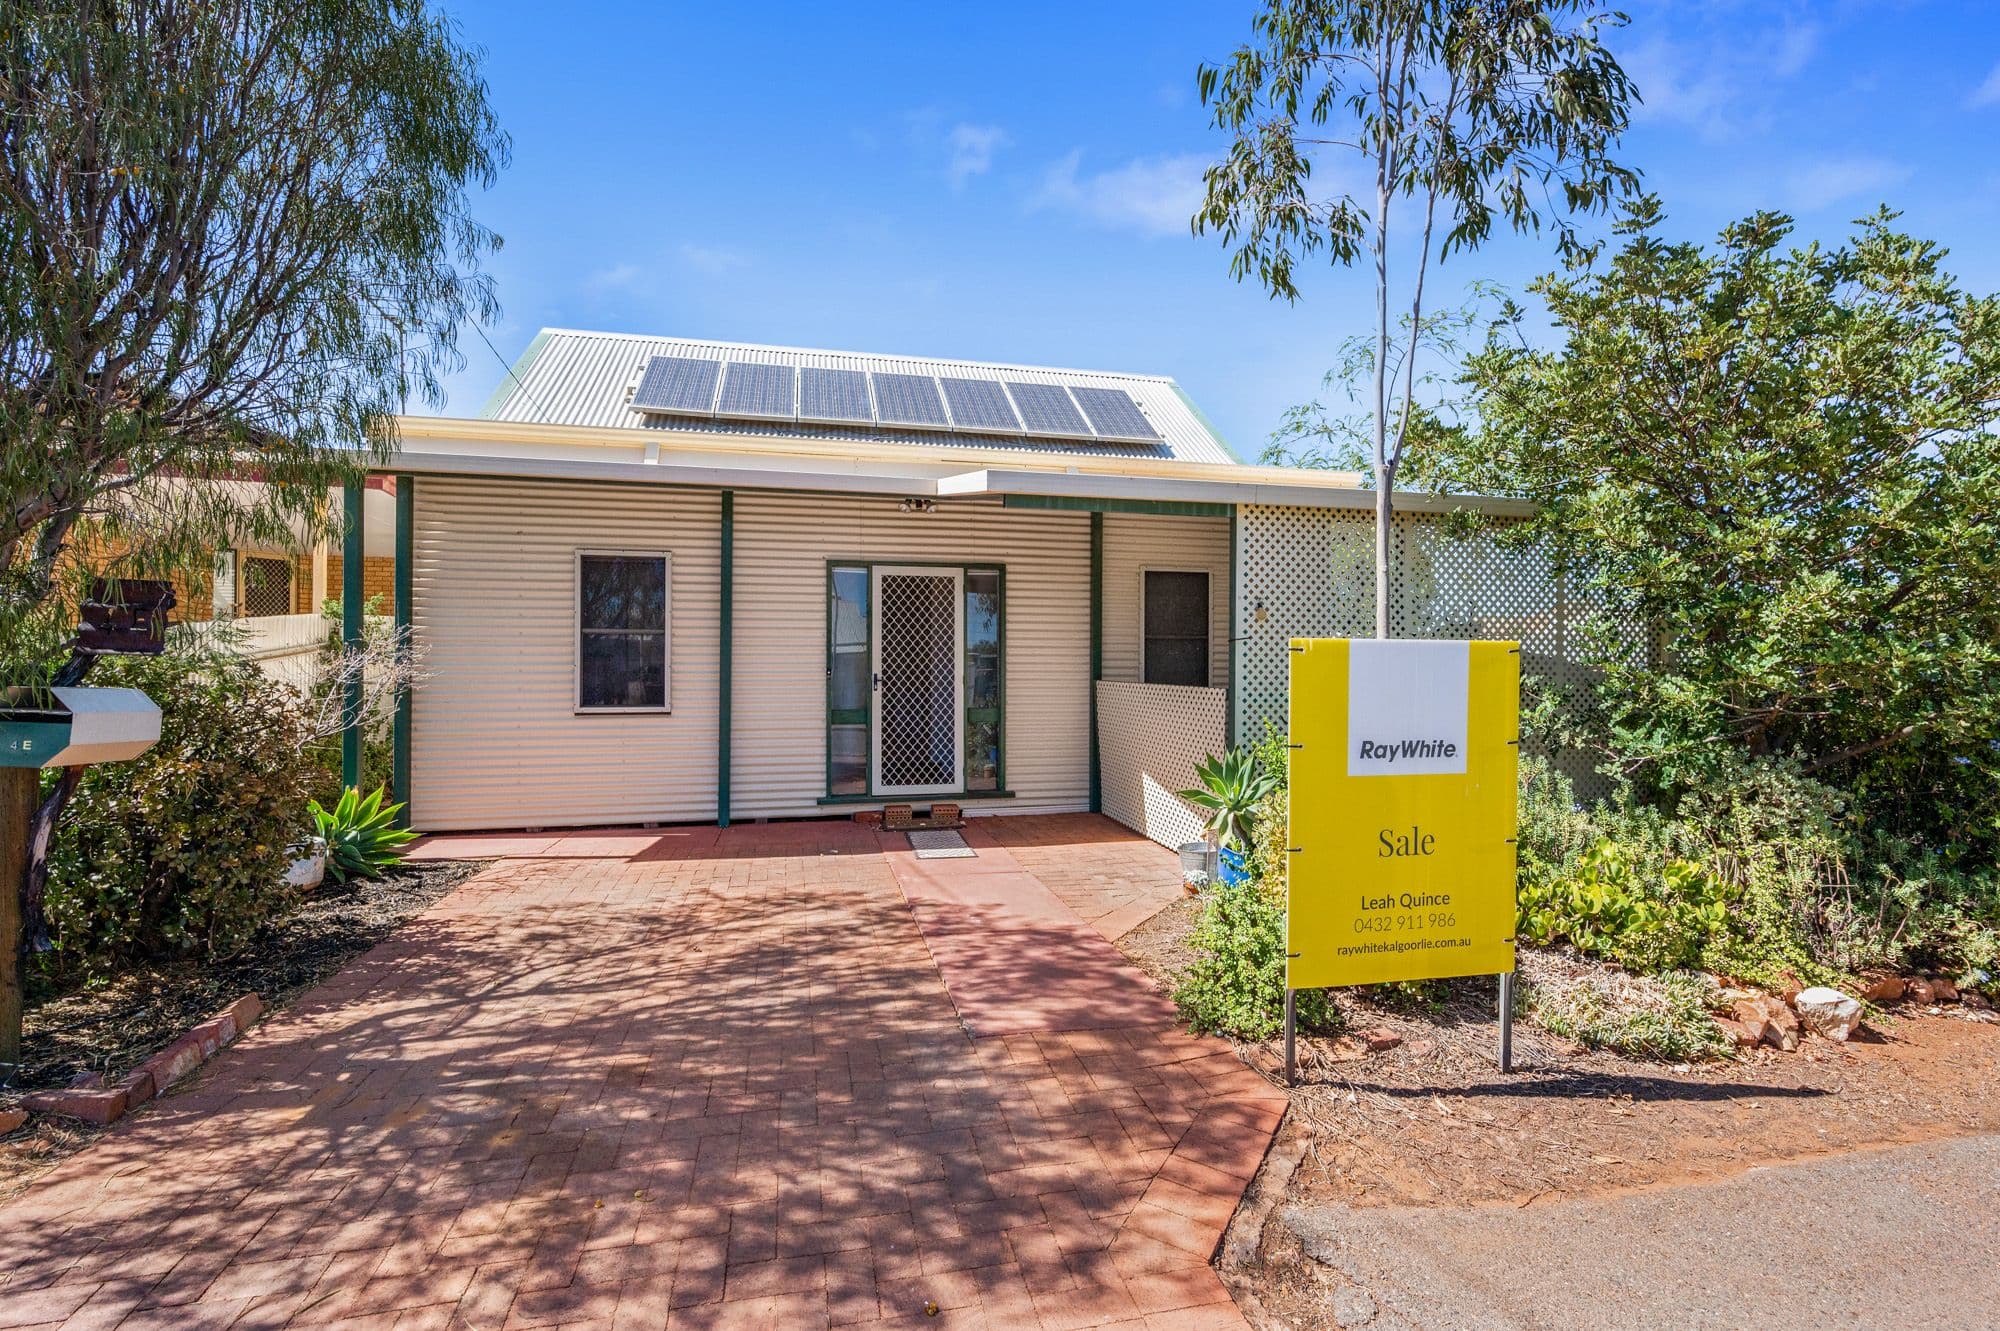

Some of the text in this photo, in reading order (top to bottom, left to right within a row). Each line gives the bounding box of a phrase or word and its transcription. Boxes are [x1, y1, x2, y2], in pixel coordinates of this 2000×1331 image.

[1379, 825, 1435, 858] Sale
[1361, 892, 1450, 910] Leah Quince
[1354, 912, 1456, 933] 0432 911 986
[1337, 938, 1471, 957] raywhitekalgoorlie.com.au
